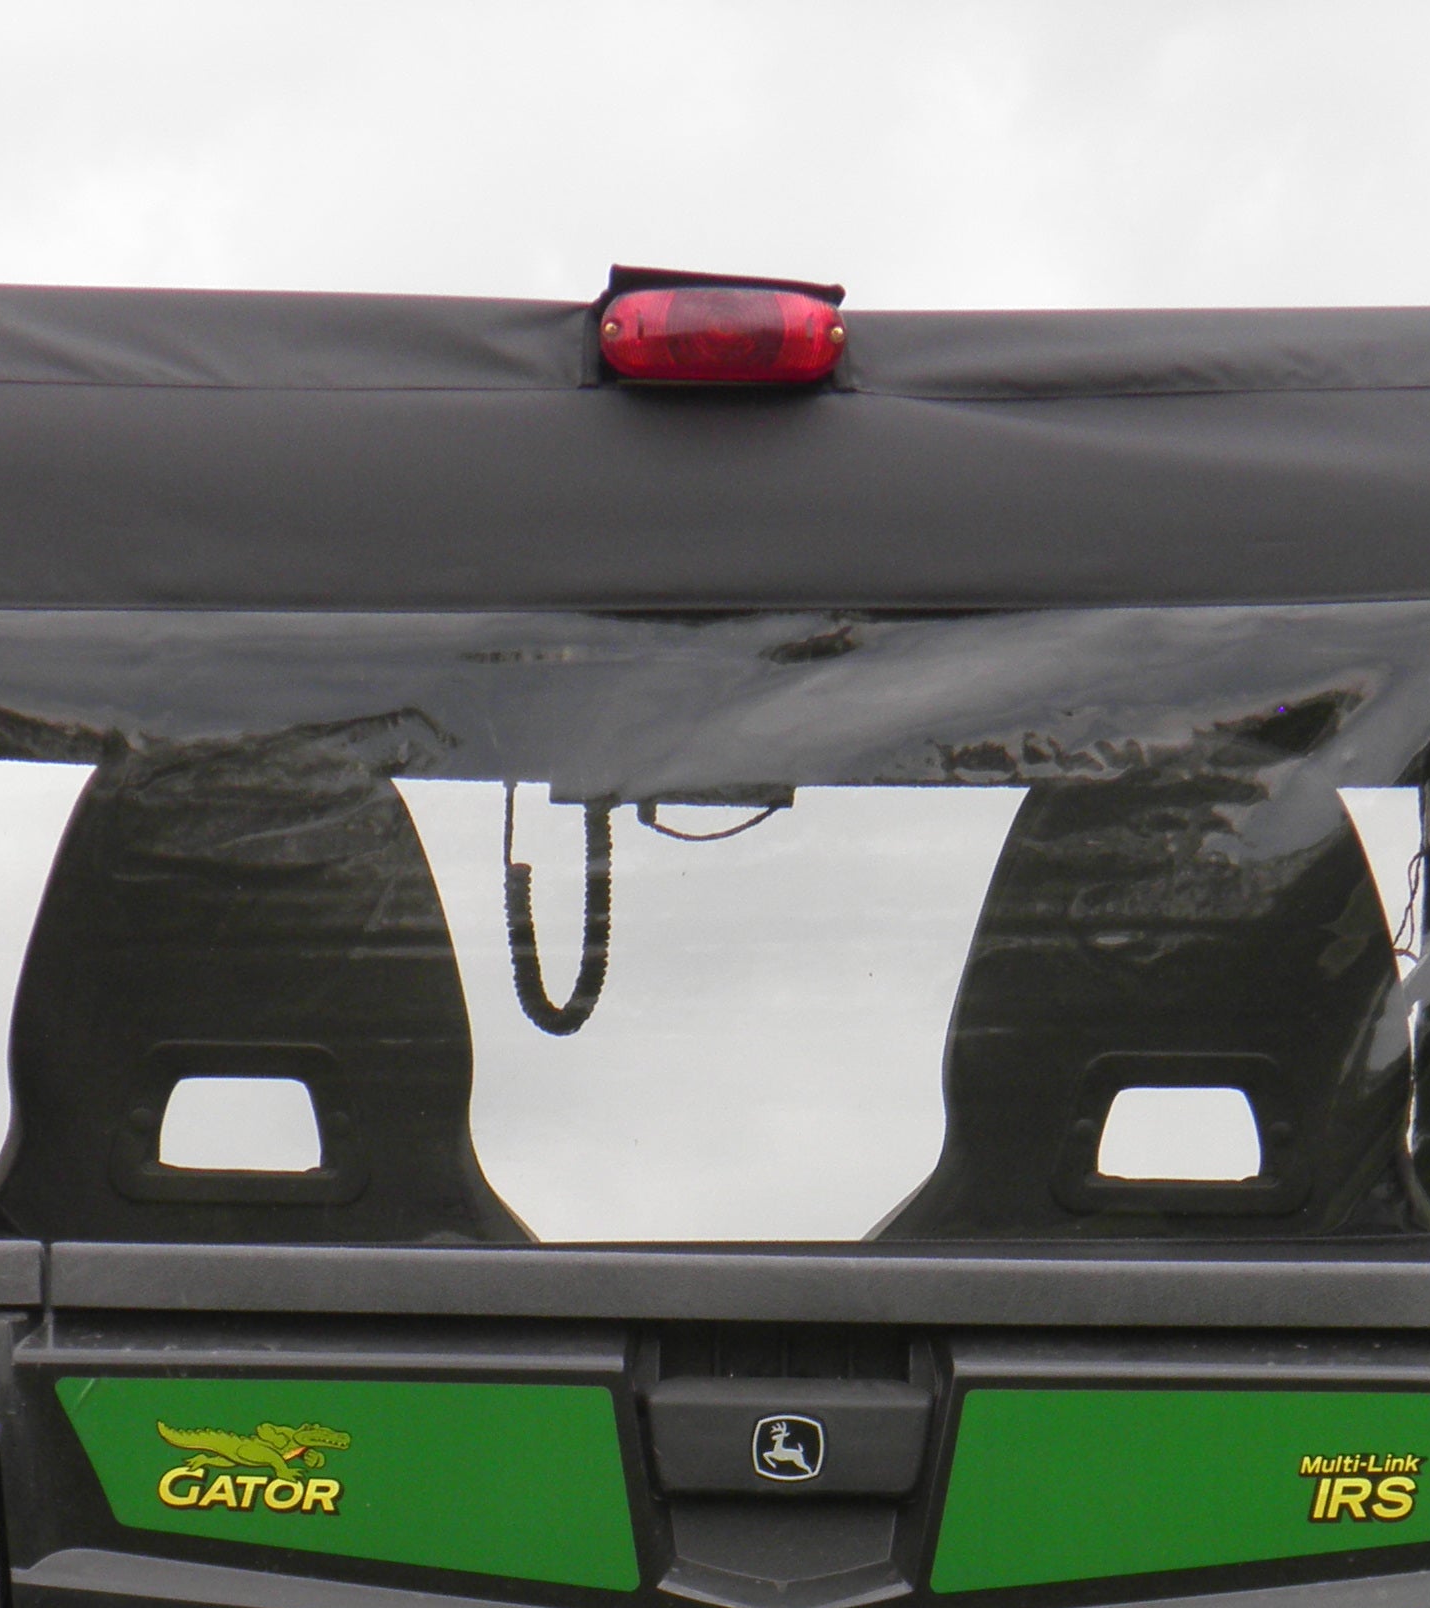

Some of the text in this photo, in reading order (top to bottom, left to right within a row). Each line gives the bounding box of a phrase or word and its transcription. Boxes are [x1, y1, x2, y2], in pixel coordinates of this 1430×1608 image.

[1299, 1453, 1421, 1475] Multi-Link
[157, 1466, 342, 1513] GATOR
[1312, 1475, 1417, 1520] IRS
